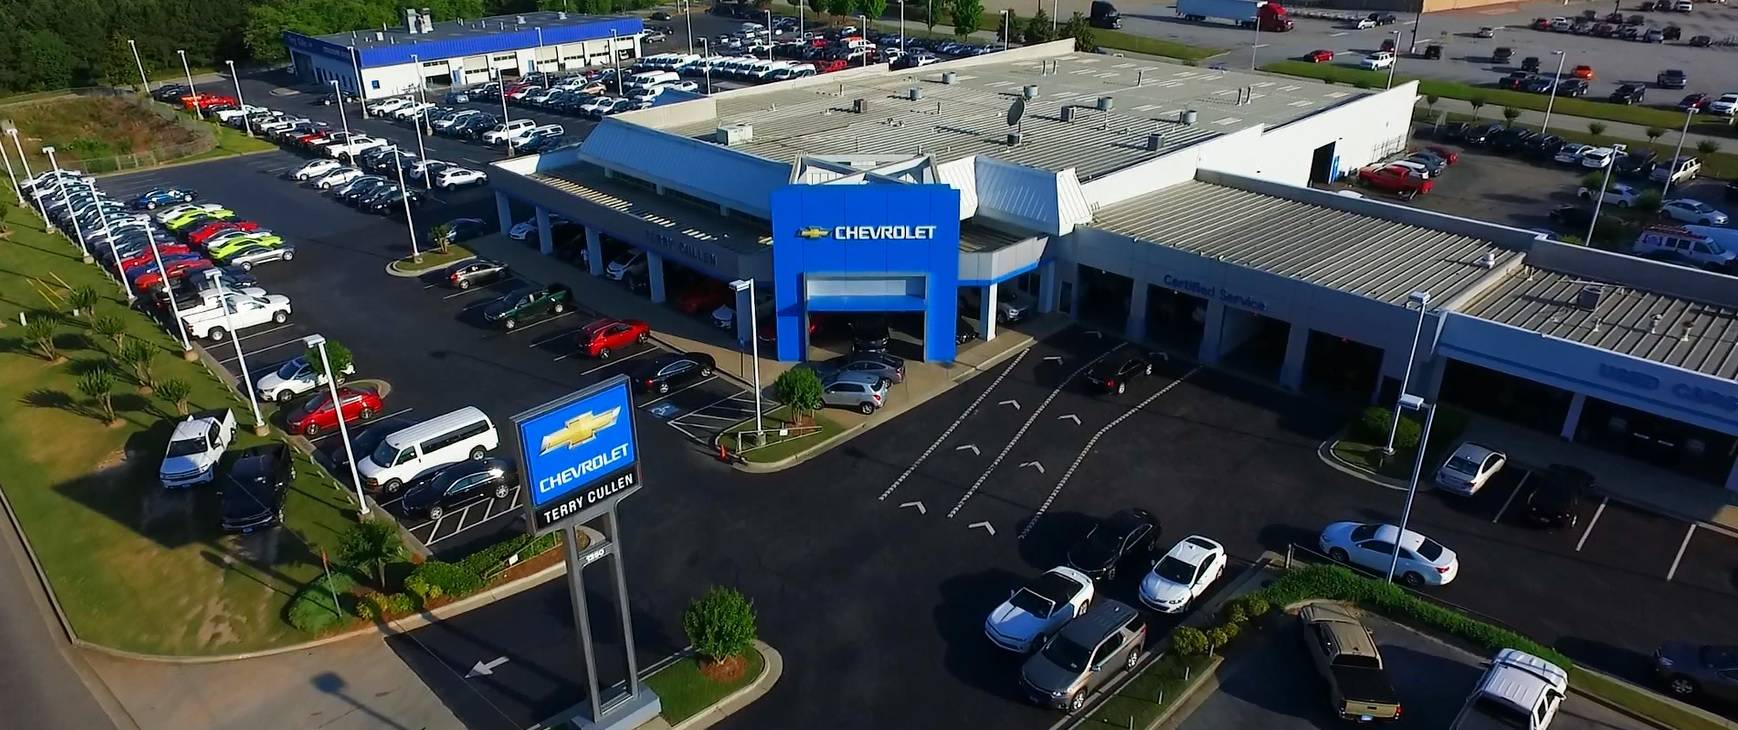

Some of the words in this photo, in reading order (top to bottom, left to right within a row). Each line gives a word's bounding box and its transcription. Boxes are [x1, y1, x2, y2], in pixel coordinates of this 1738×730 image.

[835, 225, 937, 240] CHEVROLET
[1164, 274, 1216, 298] Certified
[539, 443, 629, 493] CHEVROLET
[544, 496, 583, 523] TERRY
[589, 473, 633, 503] CULLEN
